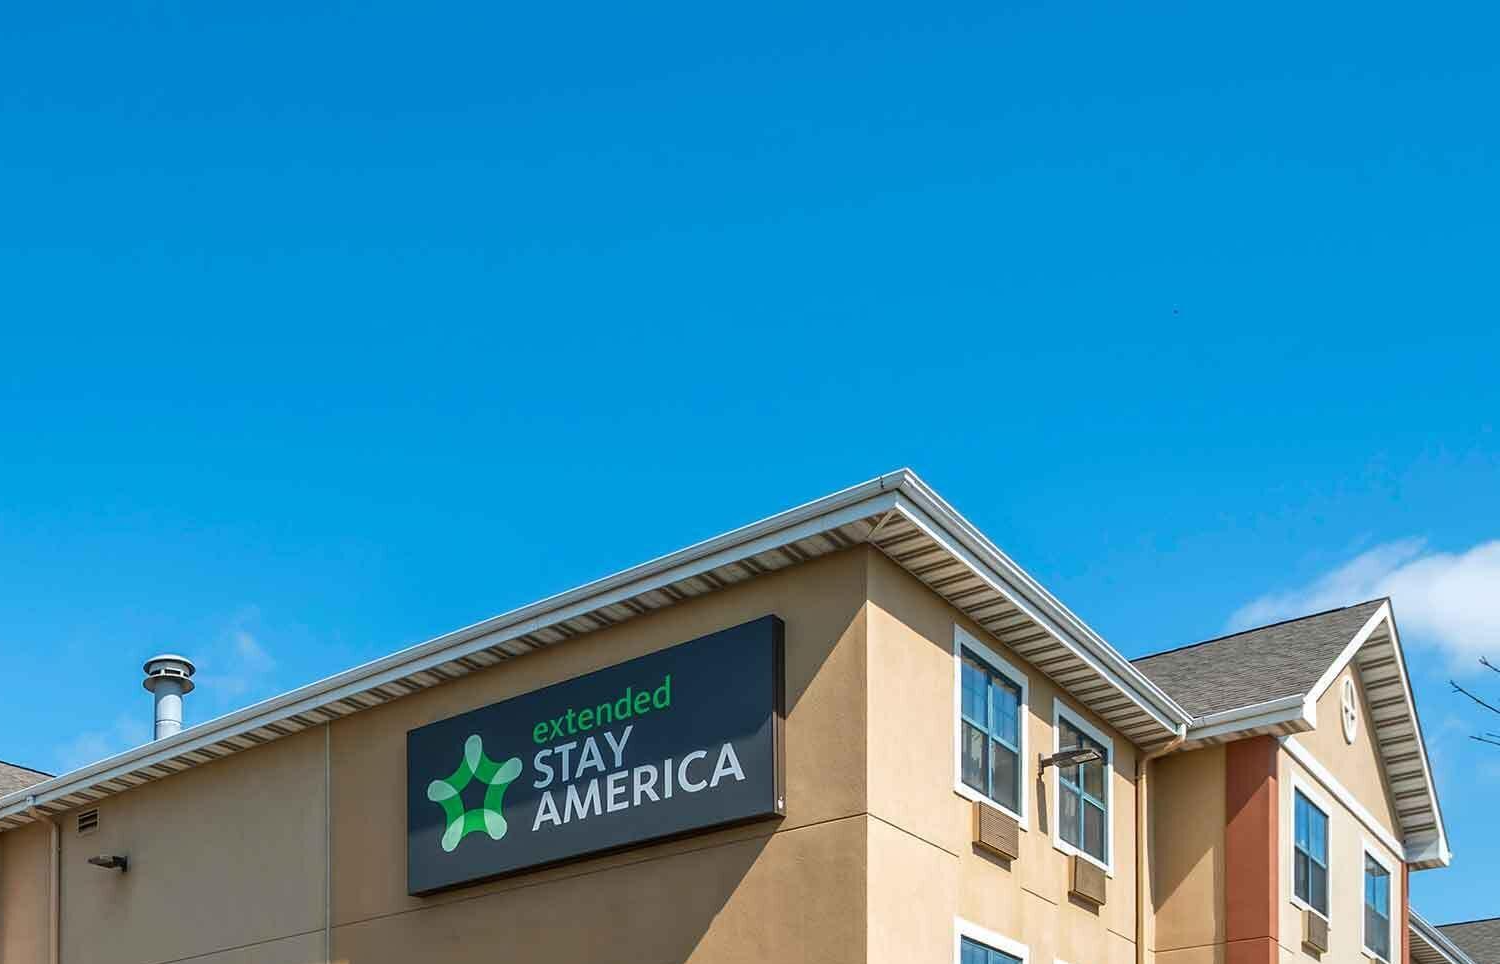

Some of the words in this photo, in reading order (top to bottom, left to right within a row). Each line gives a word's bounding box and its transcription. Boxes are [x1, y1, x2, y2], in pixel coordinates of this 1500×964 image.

[532, 674, 672, 744] extended
[531, 742, 746, 832] AMERICA
[532, 725, 634, 790] STAY
